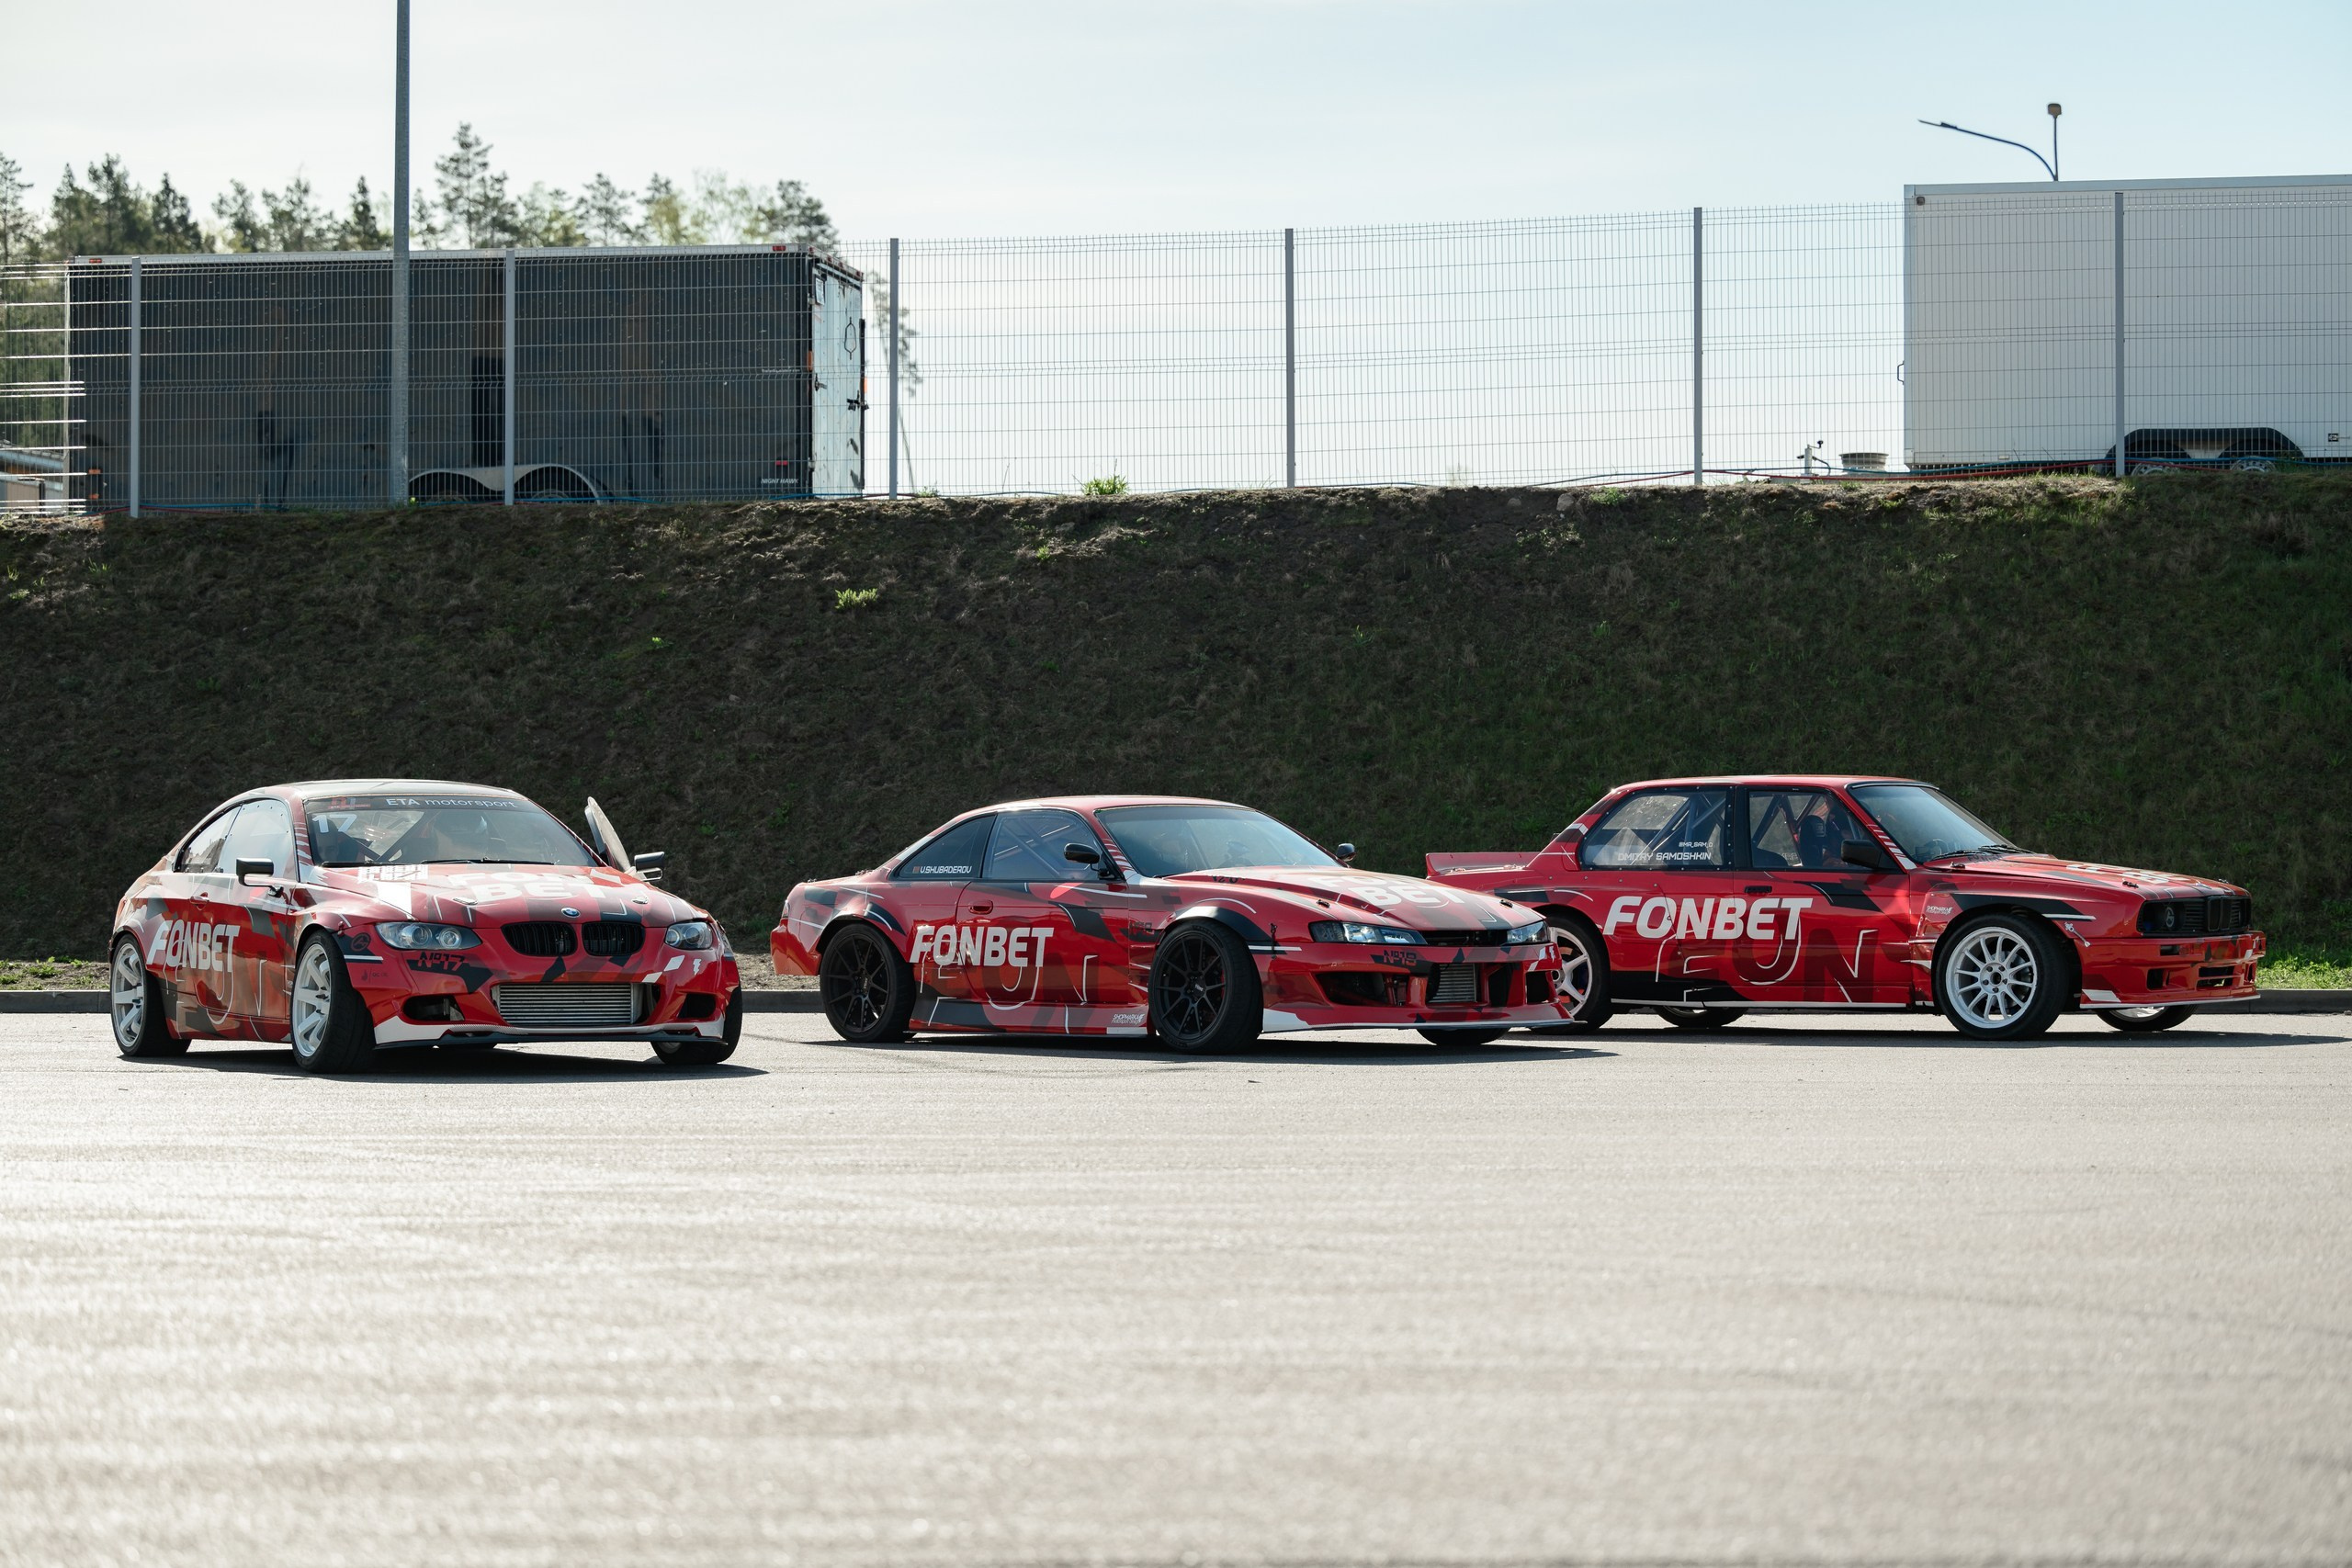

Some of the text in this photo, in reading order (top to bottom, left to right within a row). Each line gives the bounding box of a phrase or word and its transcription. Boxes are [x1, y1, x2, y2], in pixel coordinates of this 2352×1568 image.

[424, 798, 517, 808] motorsport
[311, 813, 357, 833] 17
[1617, 852, 1712, 862] DMITRY SAMOSHKIN
[471, 882, 606, 903] BET
[1348, 885, 1465, 907] BET
[1602, 896, 1814, 941] FONBET
[146, 919, 241, 973] FONBET
[909, 925, 1055, 967] FONBET
